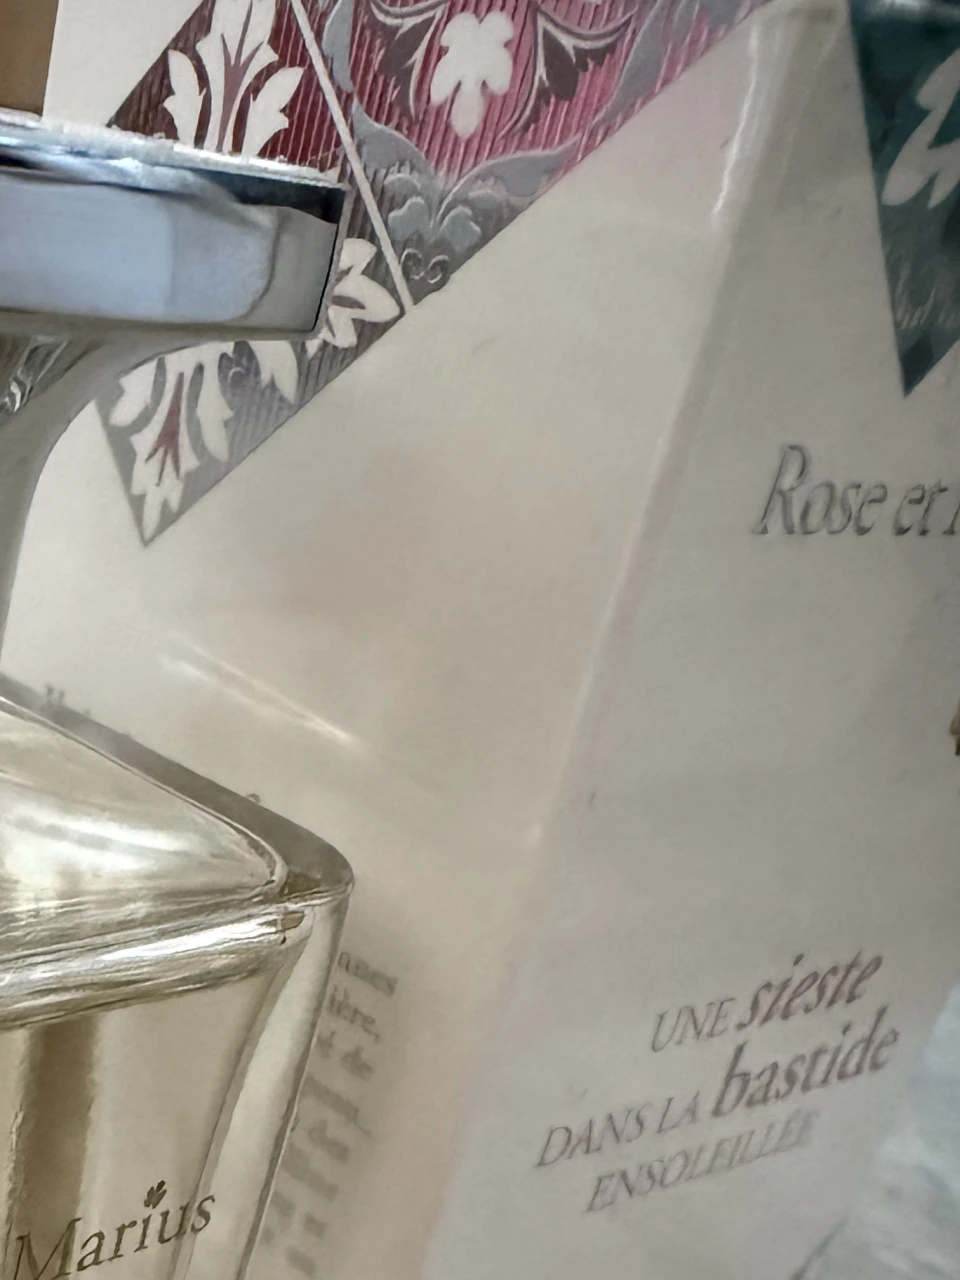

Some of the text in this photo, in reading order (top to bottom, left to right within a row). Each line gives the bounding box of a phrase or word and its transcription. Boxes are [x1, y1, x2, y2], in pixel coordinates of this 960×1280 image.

[751, 443, 888, 536] Rose
[892, 478, 949, 536] et
[651, 949, 884, 1053] UNE sieste
[537, 1004, 900, 1168] DANS LA bastide
